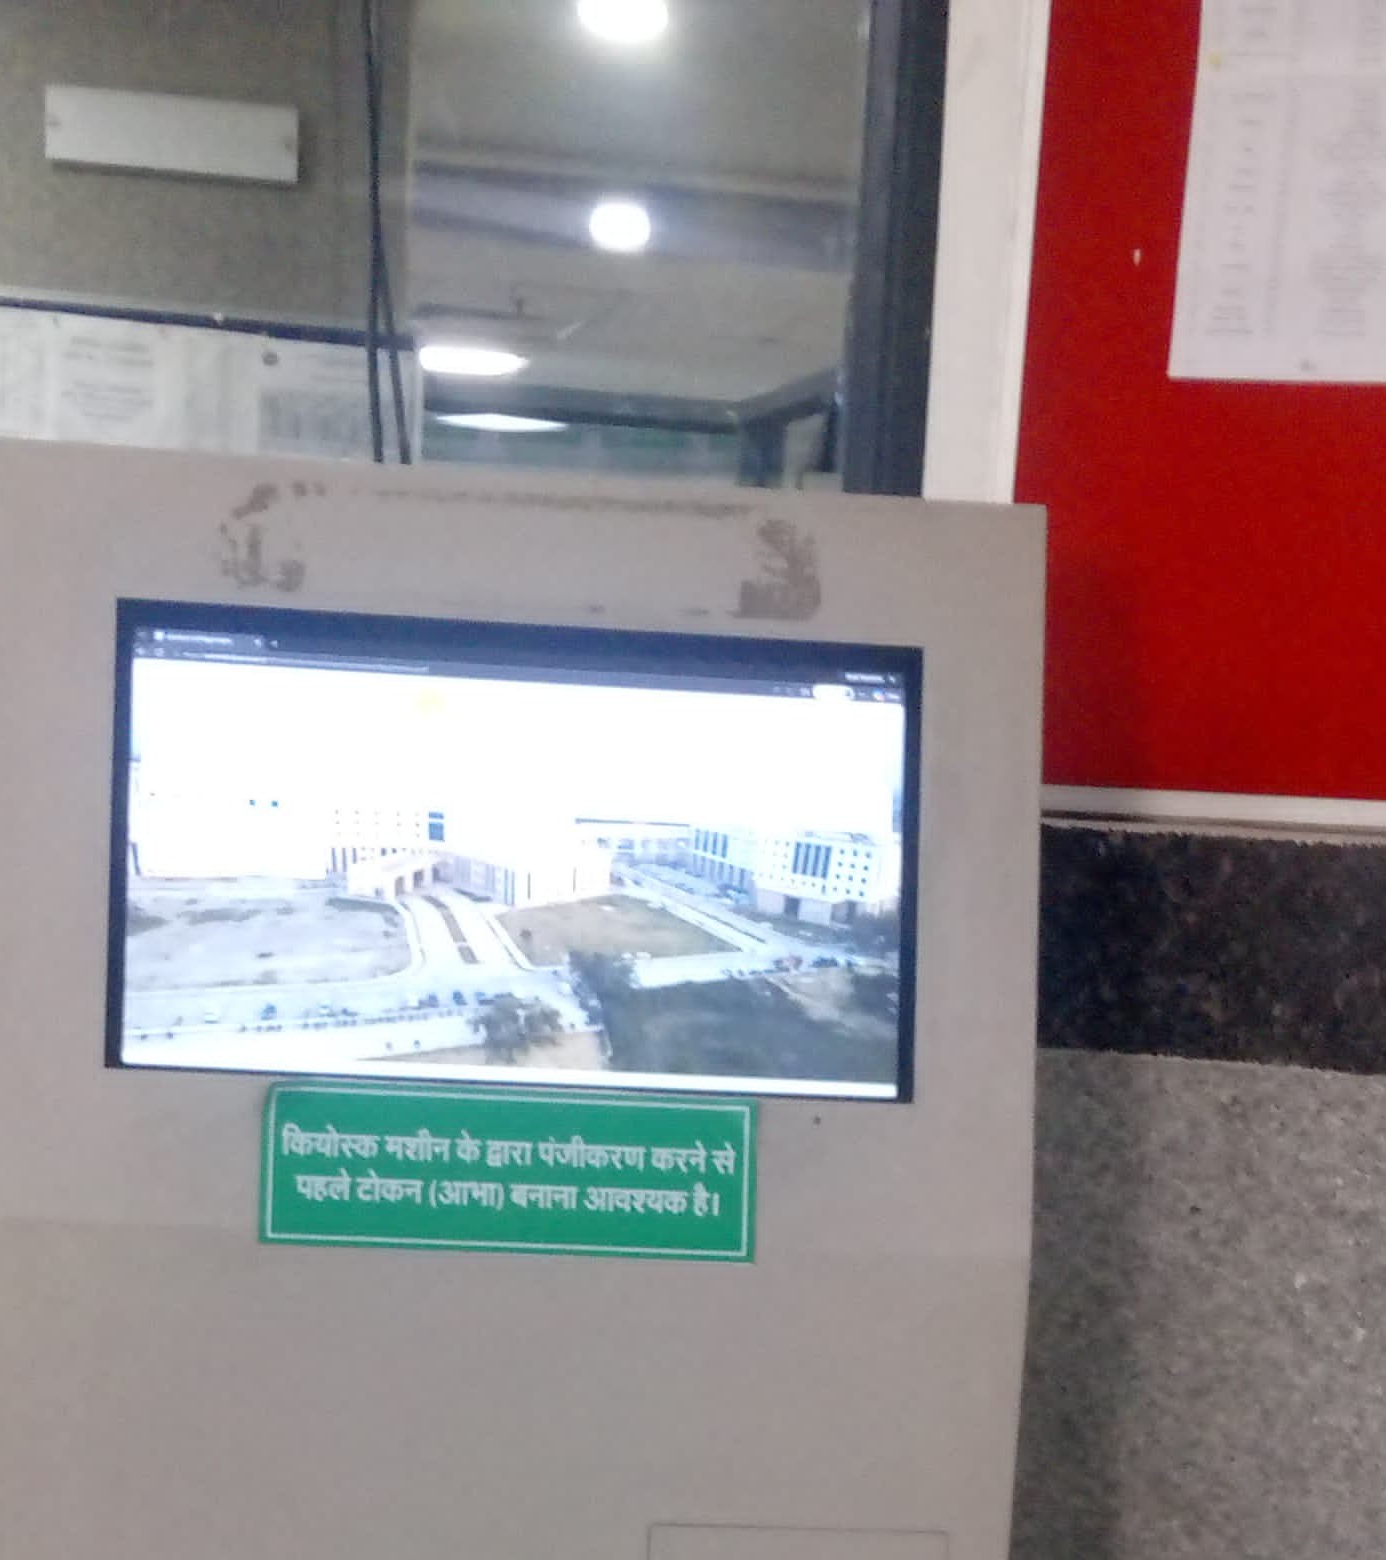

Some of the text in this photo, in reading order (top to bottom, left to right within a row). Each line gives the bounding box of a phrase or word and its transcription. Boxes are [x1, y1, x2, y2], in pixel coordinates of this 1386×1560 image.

[282, 1122, 737, 1176] कियोस्क मशीन के द्वारा पंजीकरण करने से
[295, 1167, 721, 1217] पहले टोकन (आभा) बनाना आवश्यक है।
